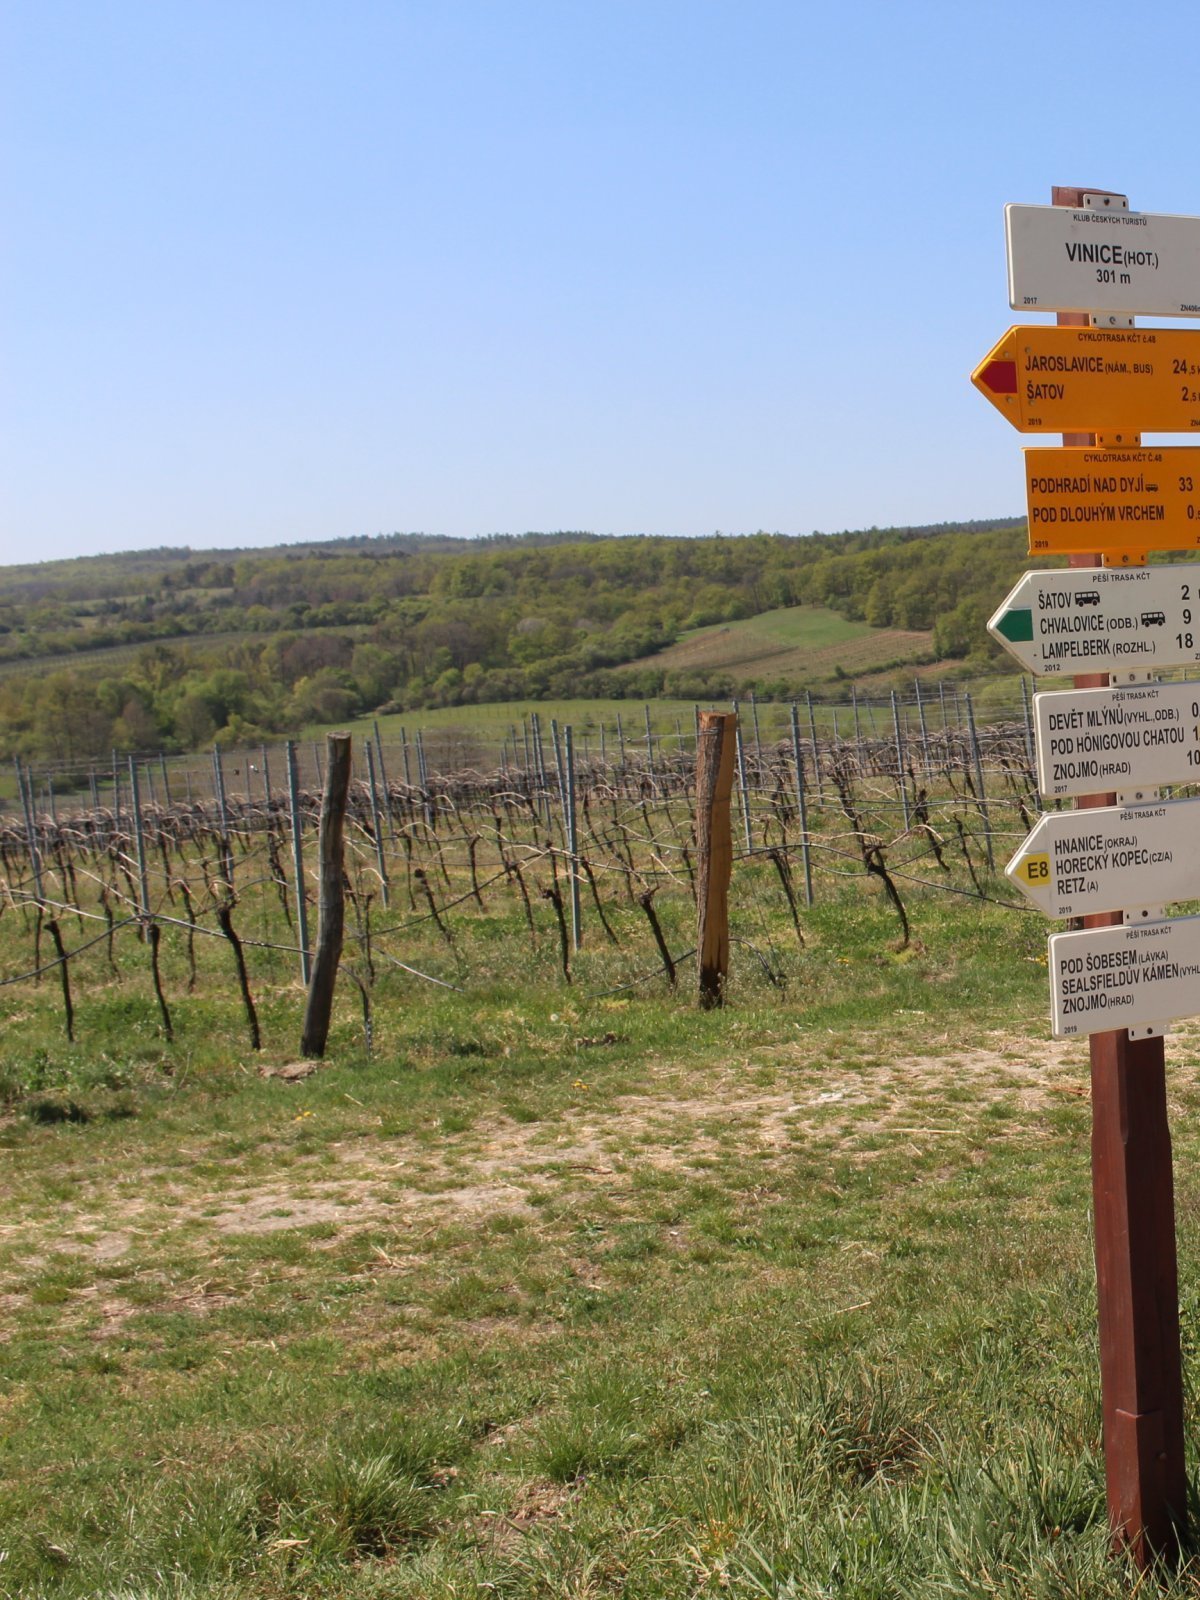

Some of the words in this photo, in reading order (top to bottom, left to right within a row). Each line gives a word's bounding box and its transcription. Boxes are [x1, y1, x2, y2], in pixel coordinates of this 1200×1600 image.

[1073, 214, 1090, 223] KLUB
[1091, 214, 1121, 225] ČESKÝCH
[1122, 216, 1147, 226] TURISTŮ
[1096, 269, 1116, 284] 301
[1120, 272, 1131, 284] m
[1023, 297, 1037, 305] 2017
[1078, 333, 1126, 343] CYKLOTRASA
[1127, 332, 1141, 343] KČT
[1025, 356, 1103, 373] JAROSLAVICE
[1133, 363, 1153, 375] BUS)
[1027, 379, 1064, 400] ŠATOV
[1028, 418, 1042, 426] 2019
[1084, 454, 1131, 463] CYKLOTRASA
[1133, 452, 1147, 462] KČT
[1031, 474, 1091, 493] PODHRADÍ
[1094, 477, 1116, 493] NAD
[1120, 473, 1144, 492] DYJÍ
[1179, 477, 1193, 492] 33
[1033, 507, 1057, 522] POD
[1060, 502, 1117, 522] DLOUHÝM
[1120, 505, 1164, 521] VRCHEM
[1034, 540, 1048, 548] 2019
[1092, 573, 1109, 583] PĚŠÍ
[1110, 573, 1135, 582] TRASA
[1136, 571, 1150, 581] KČT
[1038, 589, 1072, 610] ŠATOV
[1181, 584, 1190, 601] 2
[1040, 614, 1104, 635] CHVALOVICE
[1106, 617, 1138, 632] (ODB.)
[1183, 609, 1192, 625] 9
[1042, 638, 1110, 660] LAMPELBERK
[1112, 641, 1156, 657] (ROZHL.)
[1175, 633, 1194, 650] 18
[1044, 664, 1061, 672] 2012
[1112, 693, 1126, 702] PĚŠÍ
[1126, 691, 1146, 701] TRASA
[1147, 690, 1159, 699] KČT
[1049, 710, 1084, 731] DEVĚT
[1051, 739, 1074, 756] POD
[1077, 732, 1140, 753] HÖNIGOVOU
[1143, 727, 1185, 745] CHATOU
[1054, 785, 1067, 794] 2017
[1120, 812, 1134, 821] PĚŠÍ
[1134, 811, 1153, 820] TRASA
[1155, 808, 1167, 818] KČT
[1027, 861, 1049, 879] E8
[1056, 852, 1108, 876] HORECKÝ
[1057, 876, 1086, 896] RETZ
[1058, 906, 1072, 915] 2019
[1126, 930, 1140, 940] PĚŠÍ
[1140, 929, 1159, 938] TRASA
[1160, 926, 1172, 936] KČT
[1060, 958, 1083, 975] POD
[1086, 949, 1137, 972] ŠOBESEM
[1062, 967, 1140, 995] SEALSFIELDŮV
[1064, 1025, 1078, 1034] 2019
